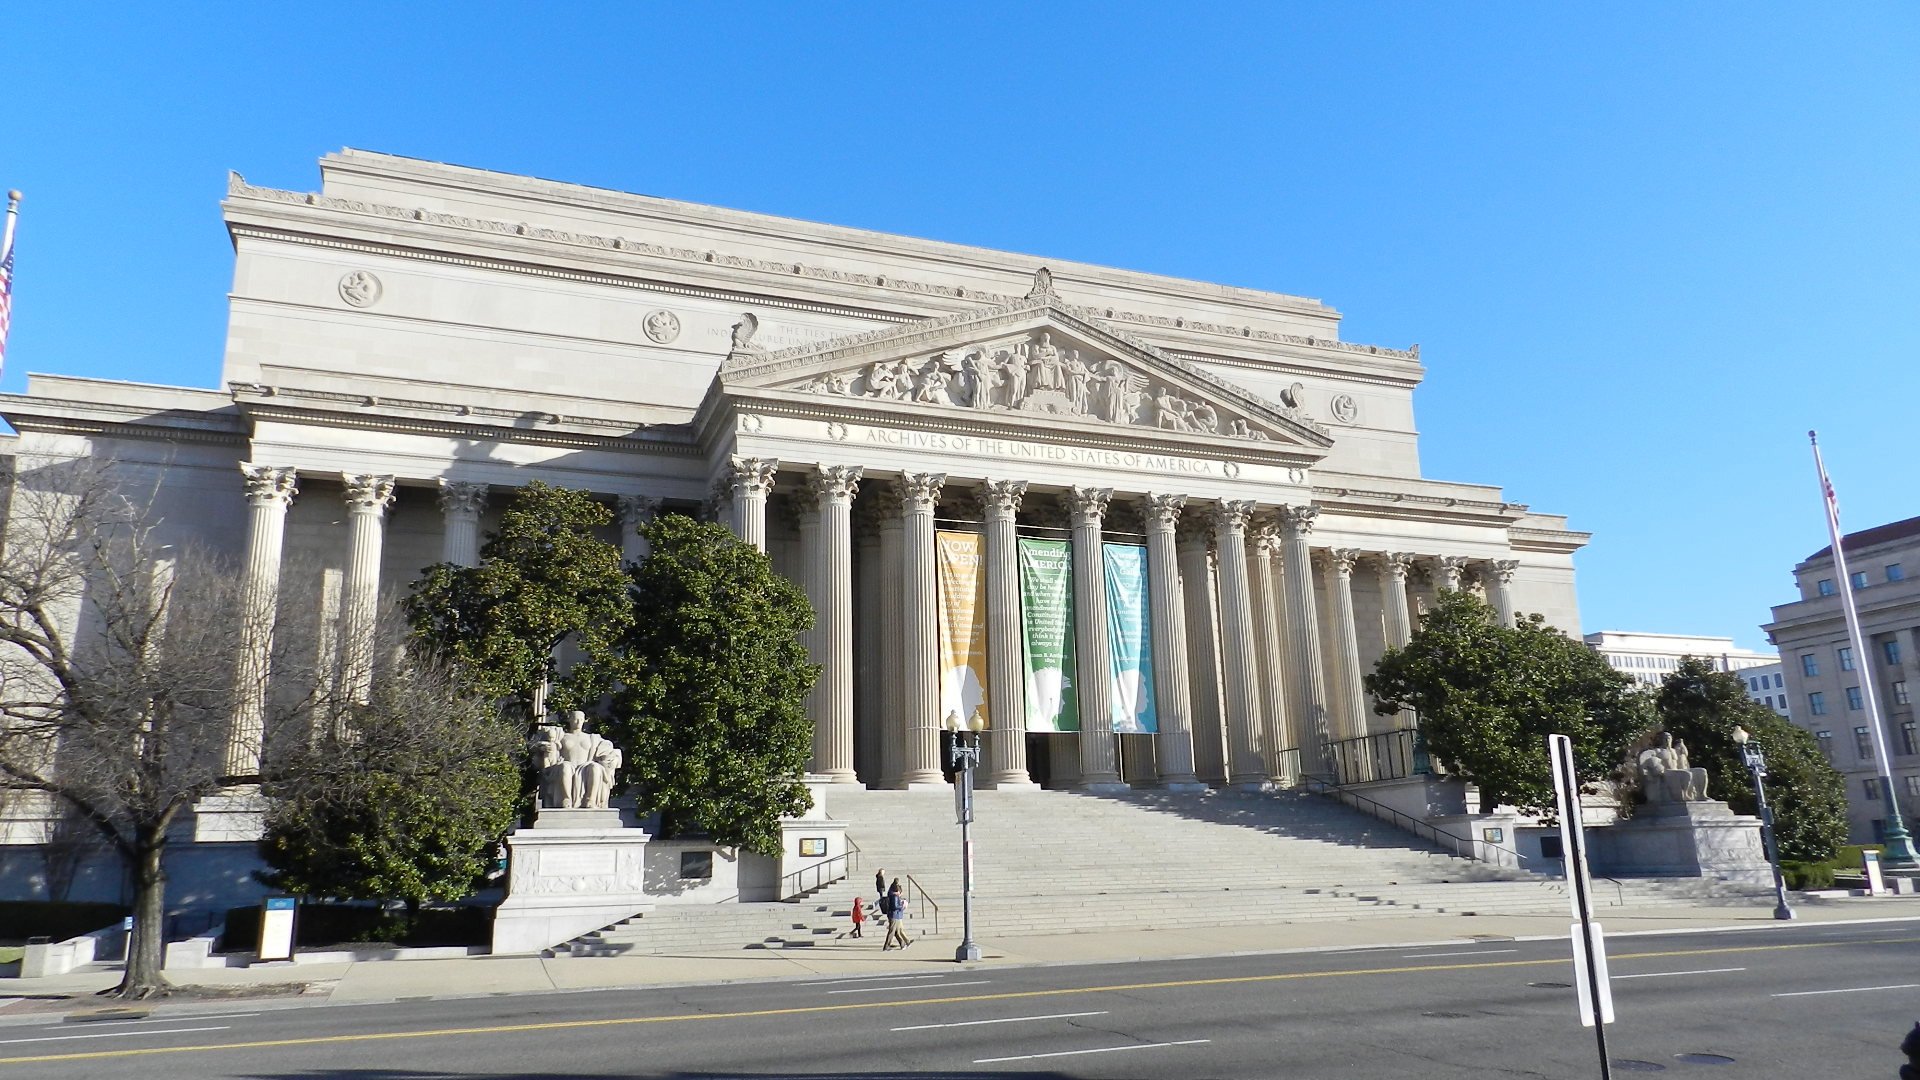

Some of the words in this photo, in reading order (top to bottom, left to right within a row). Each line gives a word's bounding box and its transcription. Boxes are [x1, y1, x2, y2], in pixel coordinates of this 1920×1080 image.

[780, 326, 799, 335] THE
[804, 328, 824, 338] TIES
[866, 429, 947, 449] ARCHIVES
[952, 437, 972, 452] OF
[976, 439, 1005, 454] THE
[1010, 443, 1066, 460] UNITED
[1071, 448, 1120, 466] STATES
[1124, 454, 1142, 467] OF
[1145, 457, 1212, 474] AMERICA
[943, 554, 983, 566] PEN!
[1024, 548, 1071, 560] mending
[1023, 560, 1072, 571] MERICA
